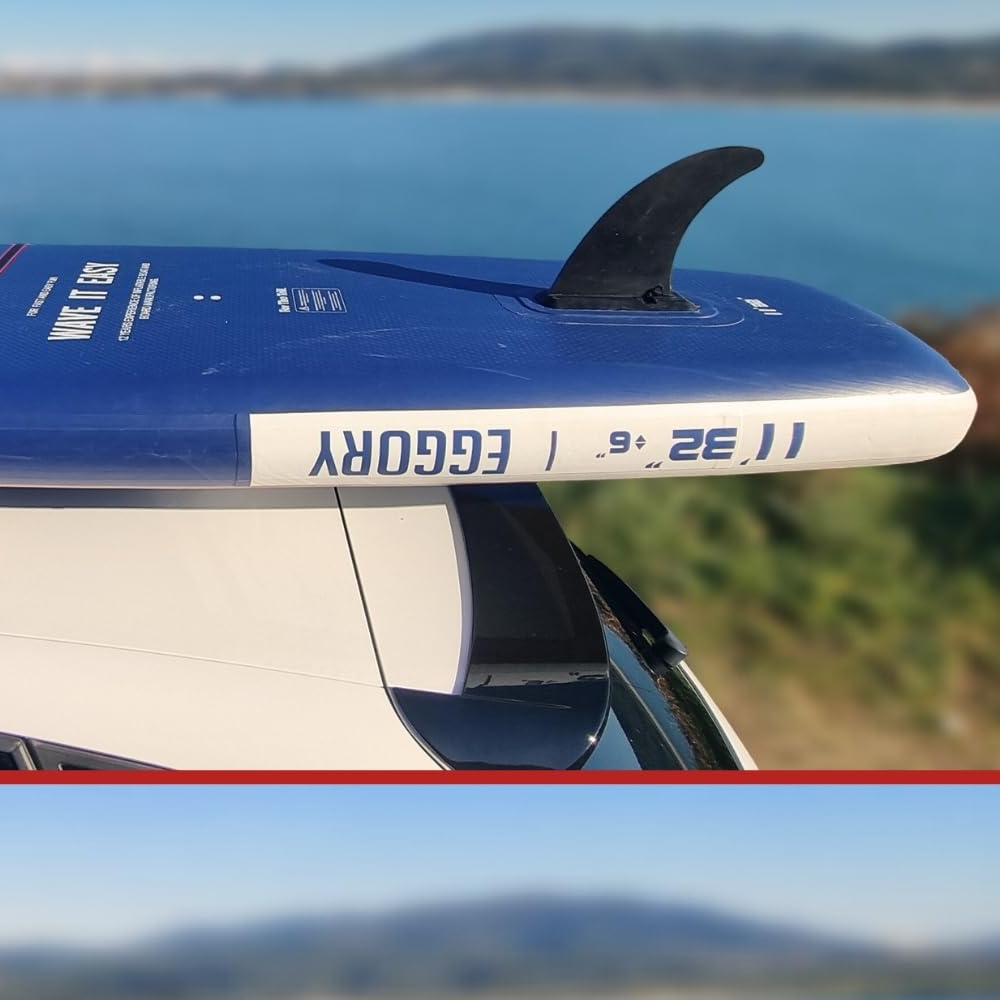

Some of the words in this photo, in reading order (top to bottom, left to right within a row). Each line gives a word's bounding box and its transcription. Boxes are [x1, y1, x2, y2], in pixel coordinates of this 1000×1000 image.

[76, 262, 120, 284] EASY
[68, 289, 109, 300] IT
[47, 306, 102, 341] WAVE
[308, 429, 512, 478] EGGORY
